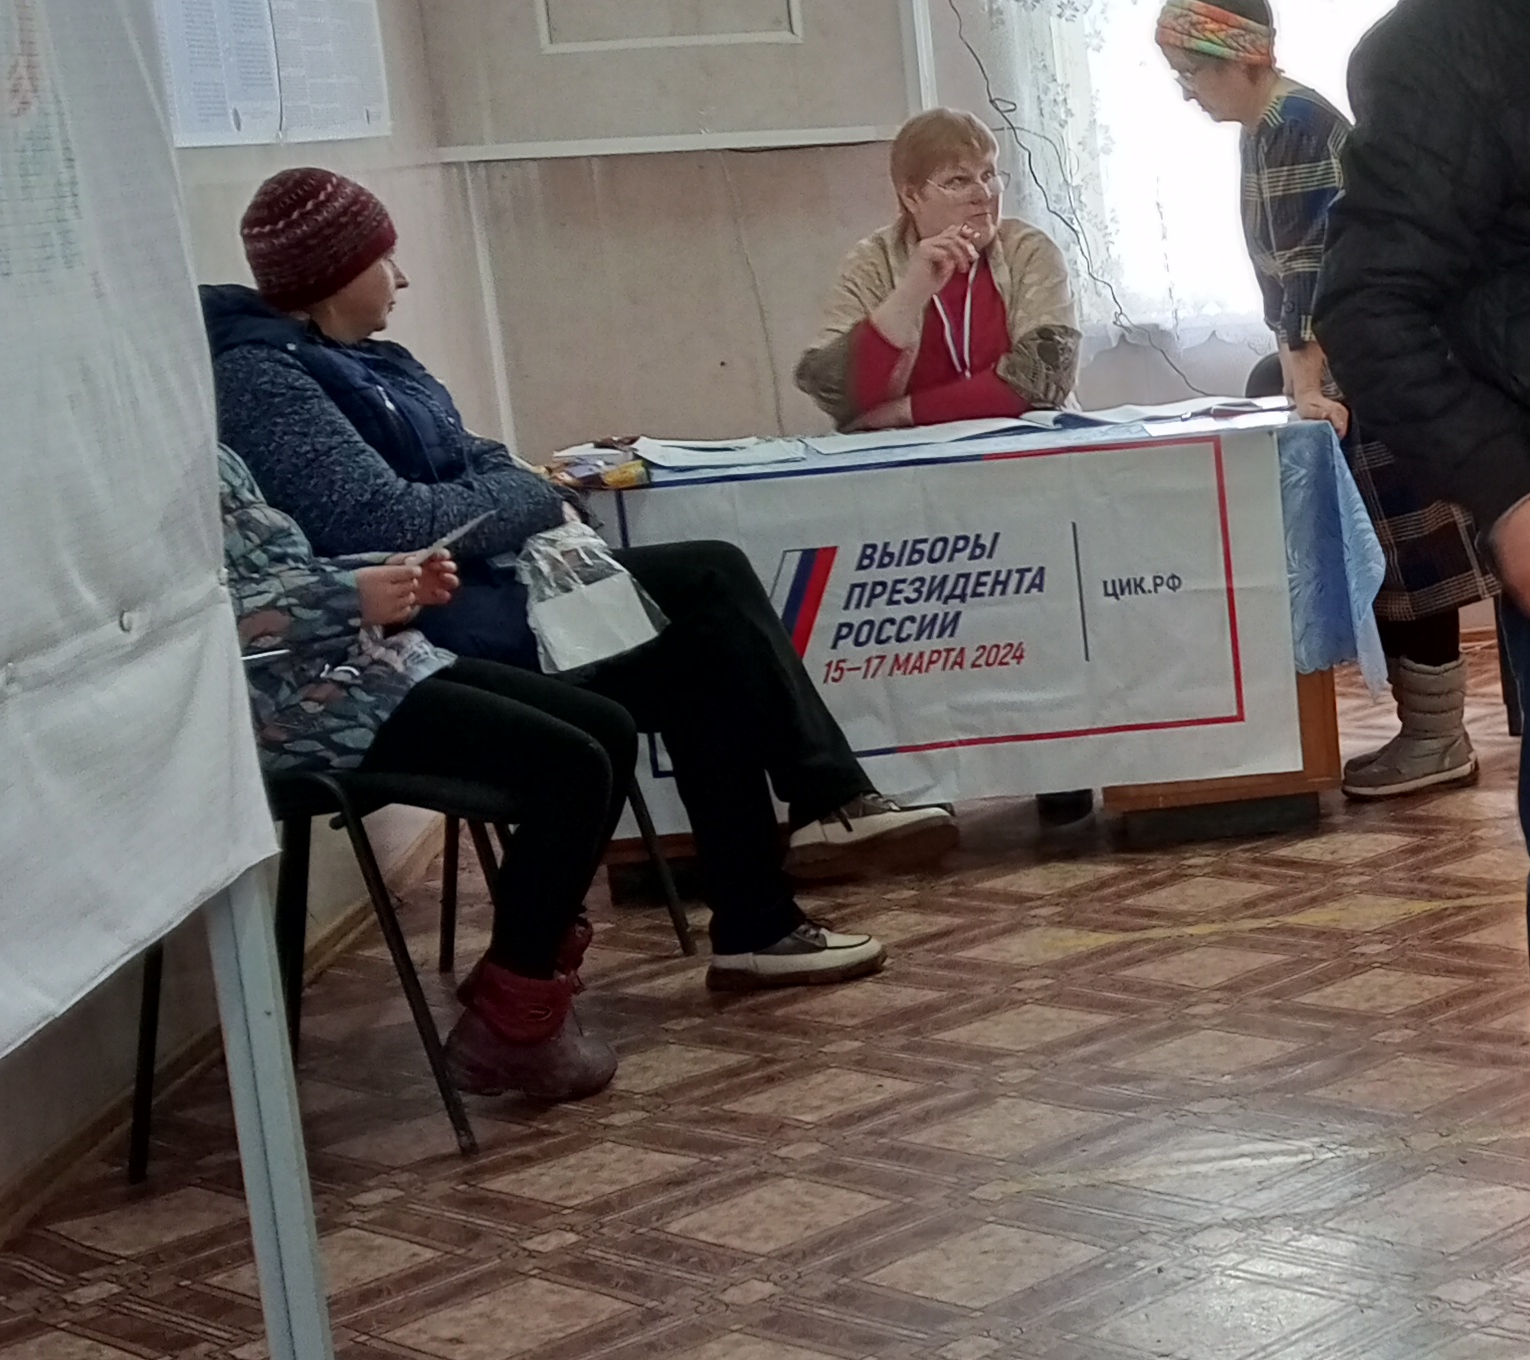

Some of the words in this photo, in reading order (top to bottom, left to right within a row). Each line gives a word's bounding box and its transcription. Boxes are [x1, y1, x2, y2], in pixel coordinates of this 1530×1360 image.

[856, 532, 1000, 570] ВЫБОРЫ
[843, 566, 1045, 610] ПРЕЗИДЕНТА
[1103, 573, 1183, 600] ЦИК.РФ
[832, 612, 961, 649] РОССИИ
[888, 647, 966, 677] МАРТА
[971, 642, 1025, 669] 2024
